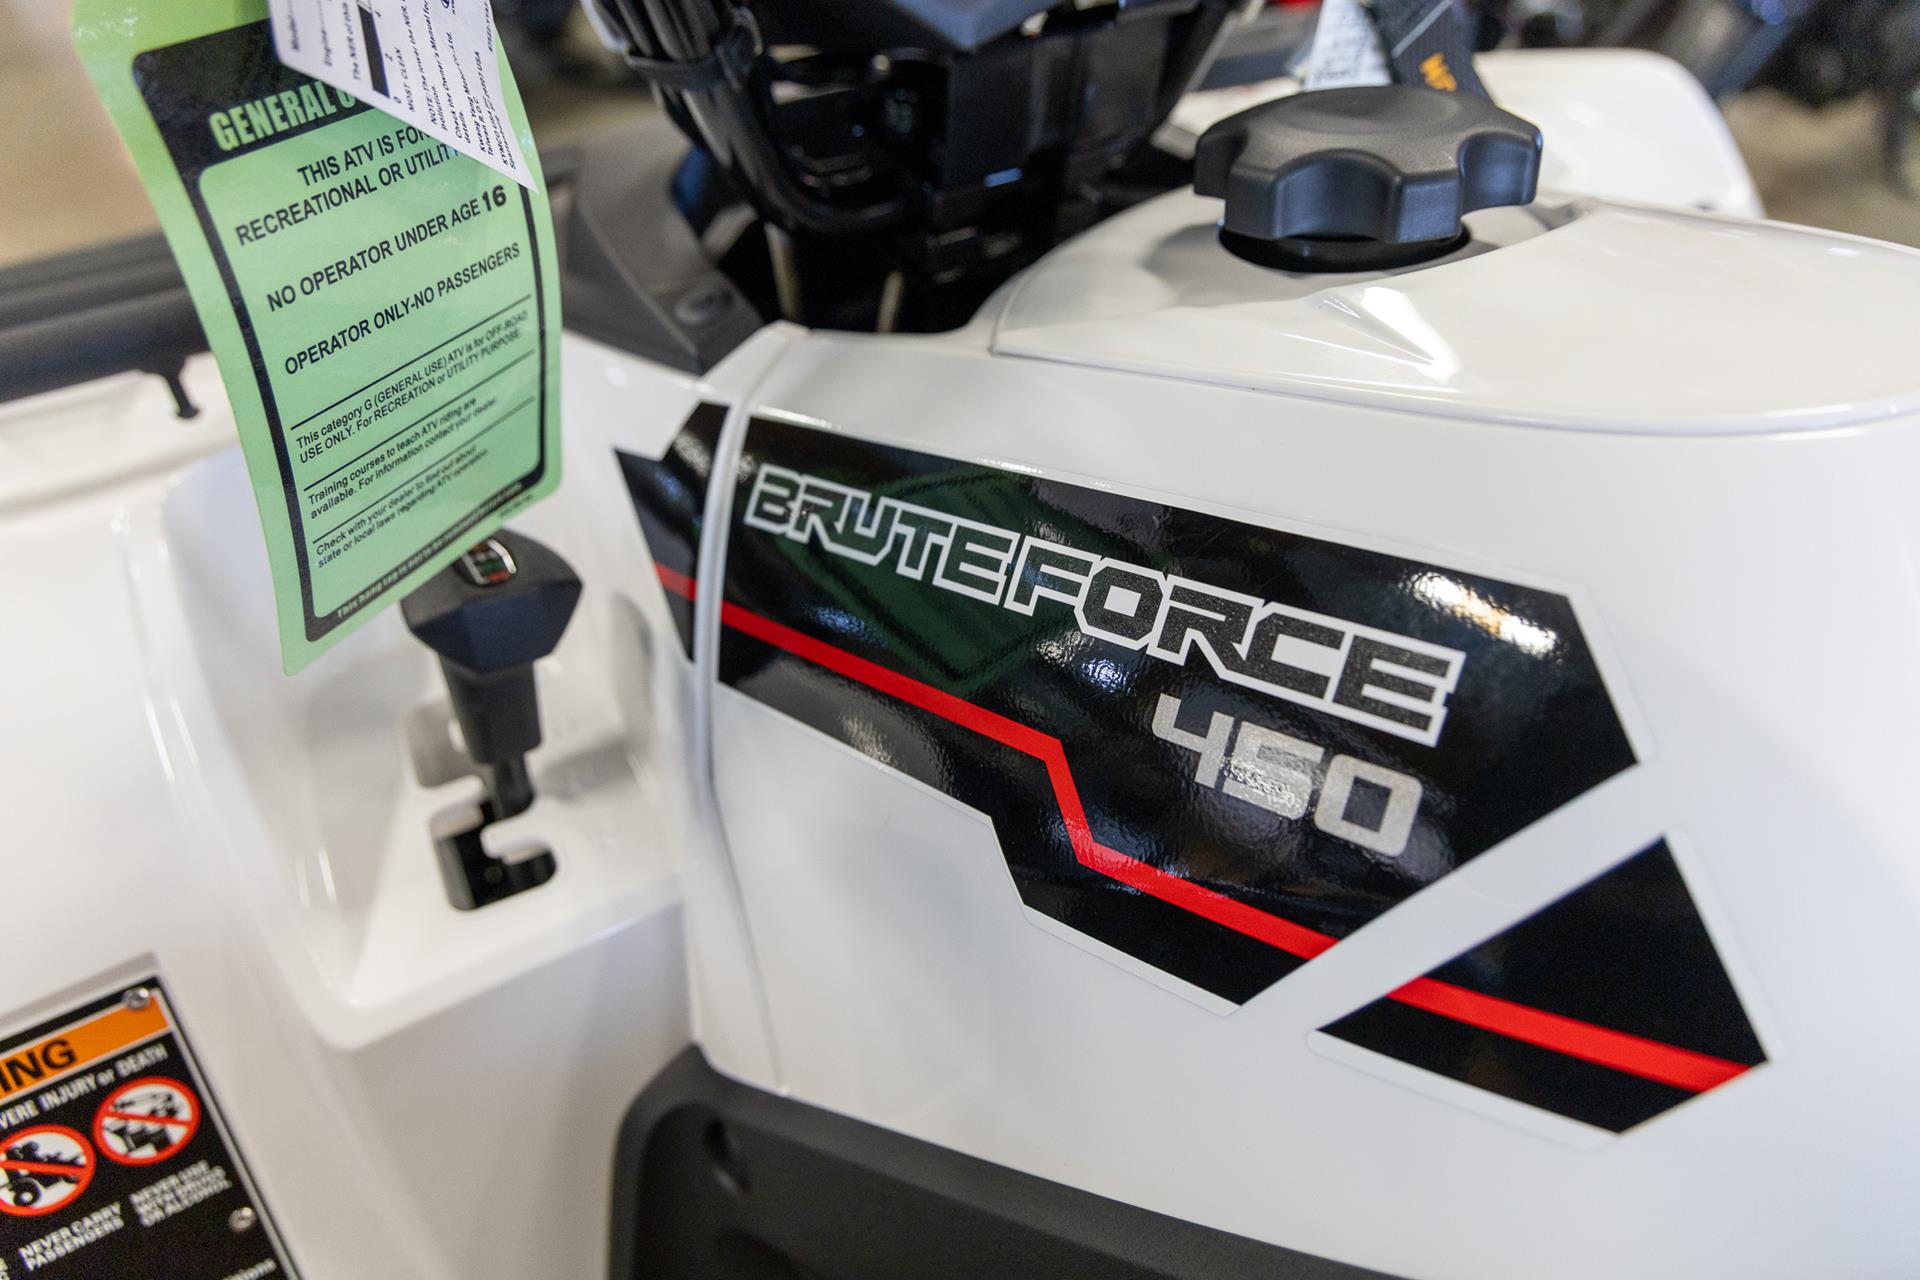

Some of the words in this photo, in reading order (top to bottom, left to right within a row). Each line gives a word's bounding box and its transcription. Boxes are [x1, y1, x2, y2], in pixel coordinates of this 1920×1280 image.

[395, 46, 408, 80] CLEAN
[408, 28, 416, 45] the
[412, 46, 424, 74] lower
[209, 79, 337, 151] GENERAL
[403, 81, 415, 112] MOST
[446, 92, 455, 108] the
[451, 109, 463, 139] Check
[467, 96, 477, 118] Yang
[297, 155, 341, 186] THIS
[344, 141, 374, 171] ATV
[377, 135, 394, 156] IS
[474, 120, 486, 153] Kwang
[482, 124, 493, 156] Taiwan
[235, 175, 377, 246] RECREATIONAL
[379, 163, 405, 187] OR
[266, 285, 296, 312] NO
[300, 240, 394, 296] OPERATOR
[394, 214, 449, 252] UNDER
[451, 198, 481, 227] AGE
[482, 185, 507, 212] 16
[284, 319, 372, 375] OPERATOR
[437, 242, 520, 297] PASSENGERS
[296, 431, 320, 449] This
[321, 406, 363, 436] category
[364, 398, 373, 411] G
[374, 371, 424, 407] (GENERAL
[424, 356, 447, 377] USE)
[447, 346, 464, 364] ATV
[300, 442, 324, 464] USE
[325, 424, 356, 449] ONLY.
[356, 415, 375, 431] For
[374, 379, 436, 421] RECREATION
[437, 373, 446, 385] or
[447, 351, 480, 379] UTILITY
[307, 476, 349, 505] Training
[349, 453, 387, 481] courses
[386, 446, 397, 458] to
[397, 431, 420, 453] teach
[421, 418, 438, 436] ATV
[311, 487, 357, 519] available.
[358, 476, 378, 490] For
[375, 443, 424, 479] information
[316, 531, 347, 556] Check
[347, 518, 367, 535] with
[367, 505, 388, 525] your
[318, 549, 342, 568] state
[342, 540, 353, 552] or
[353, 524, 376, 544] local
[376, 511, 397, 528] laws
[1151, 692, 1422, 857] 450
[38, 1073, 97, 1111] INJURY
[97, 1069, 115, 1086] or
[115, 1042, 169, 1078] DEATH
[18, 1226, 72, 1261] NEVER
[70, 1202, 121, 1238] CARRY
[25, 1215, 124, 1271] PASSENGERS
